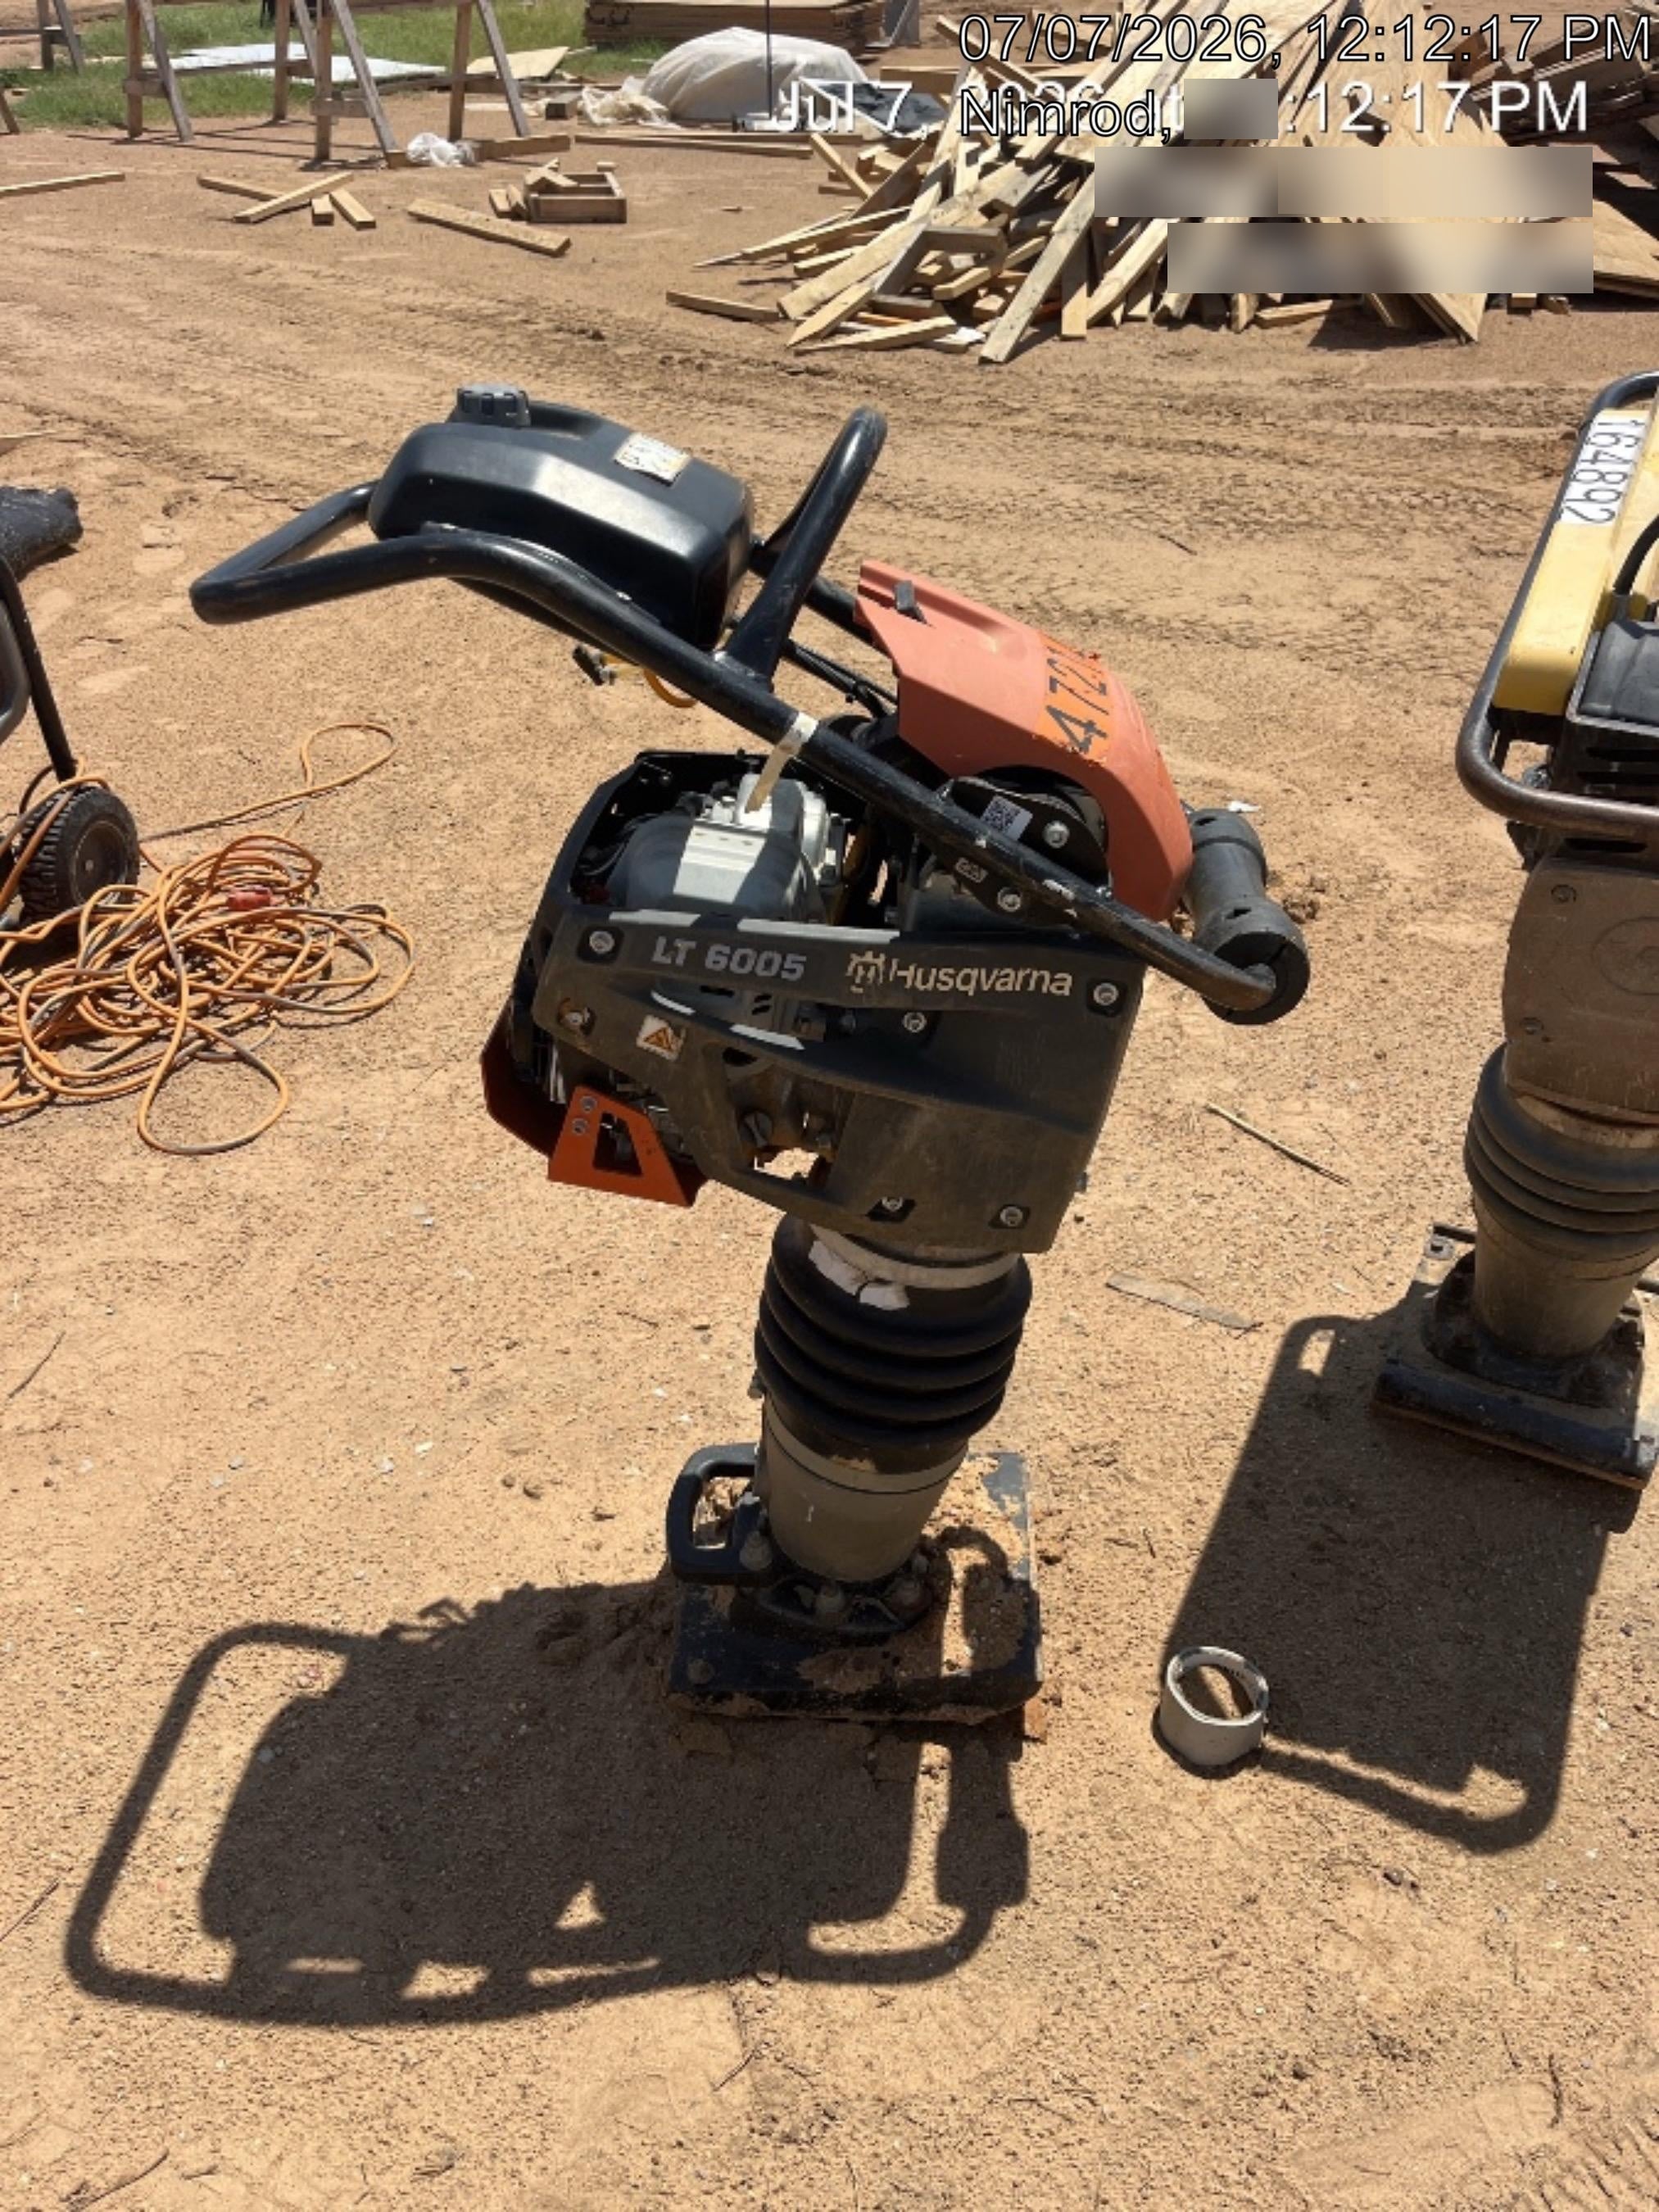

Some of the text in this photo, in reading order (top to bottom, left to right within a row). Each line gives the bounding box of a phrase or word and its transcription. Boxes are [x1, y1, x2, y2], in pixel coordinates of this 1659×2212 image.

[1559, 419, 1646, 523] 164892
[652, 936, 807, 981] LT 6005
[889, 958, 1073, 996] Husqvarna
